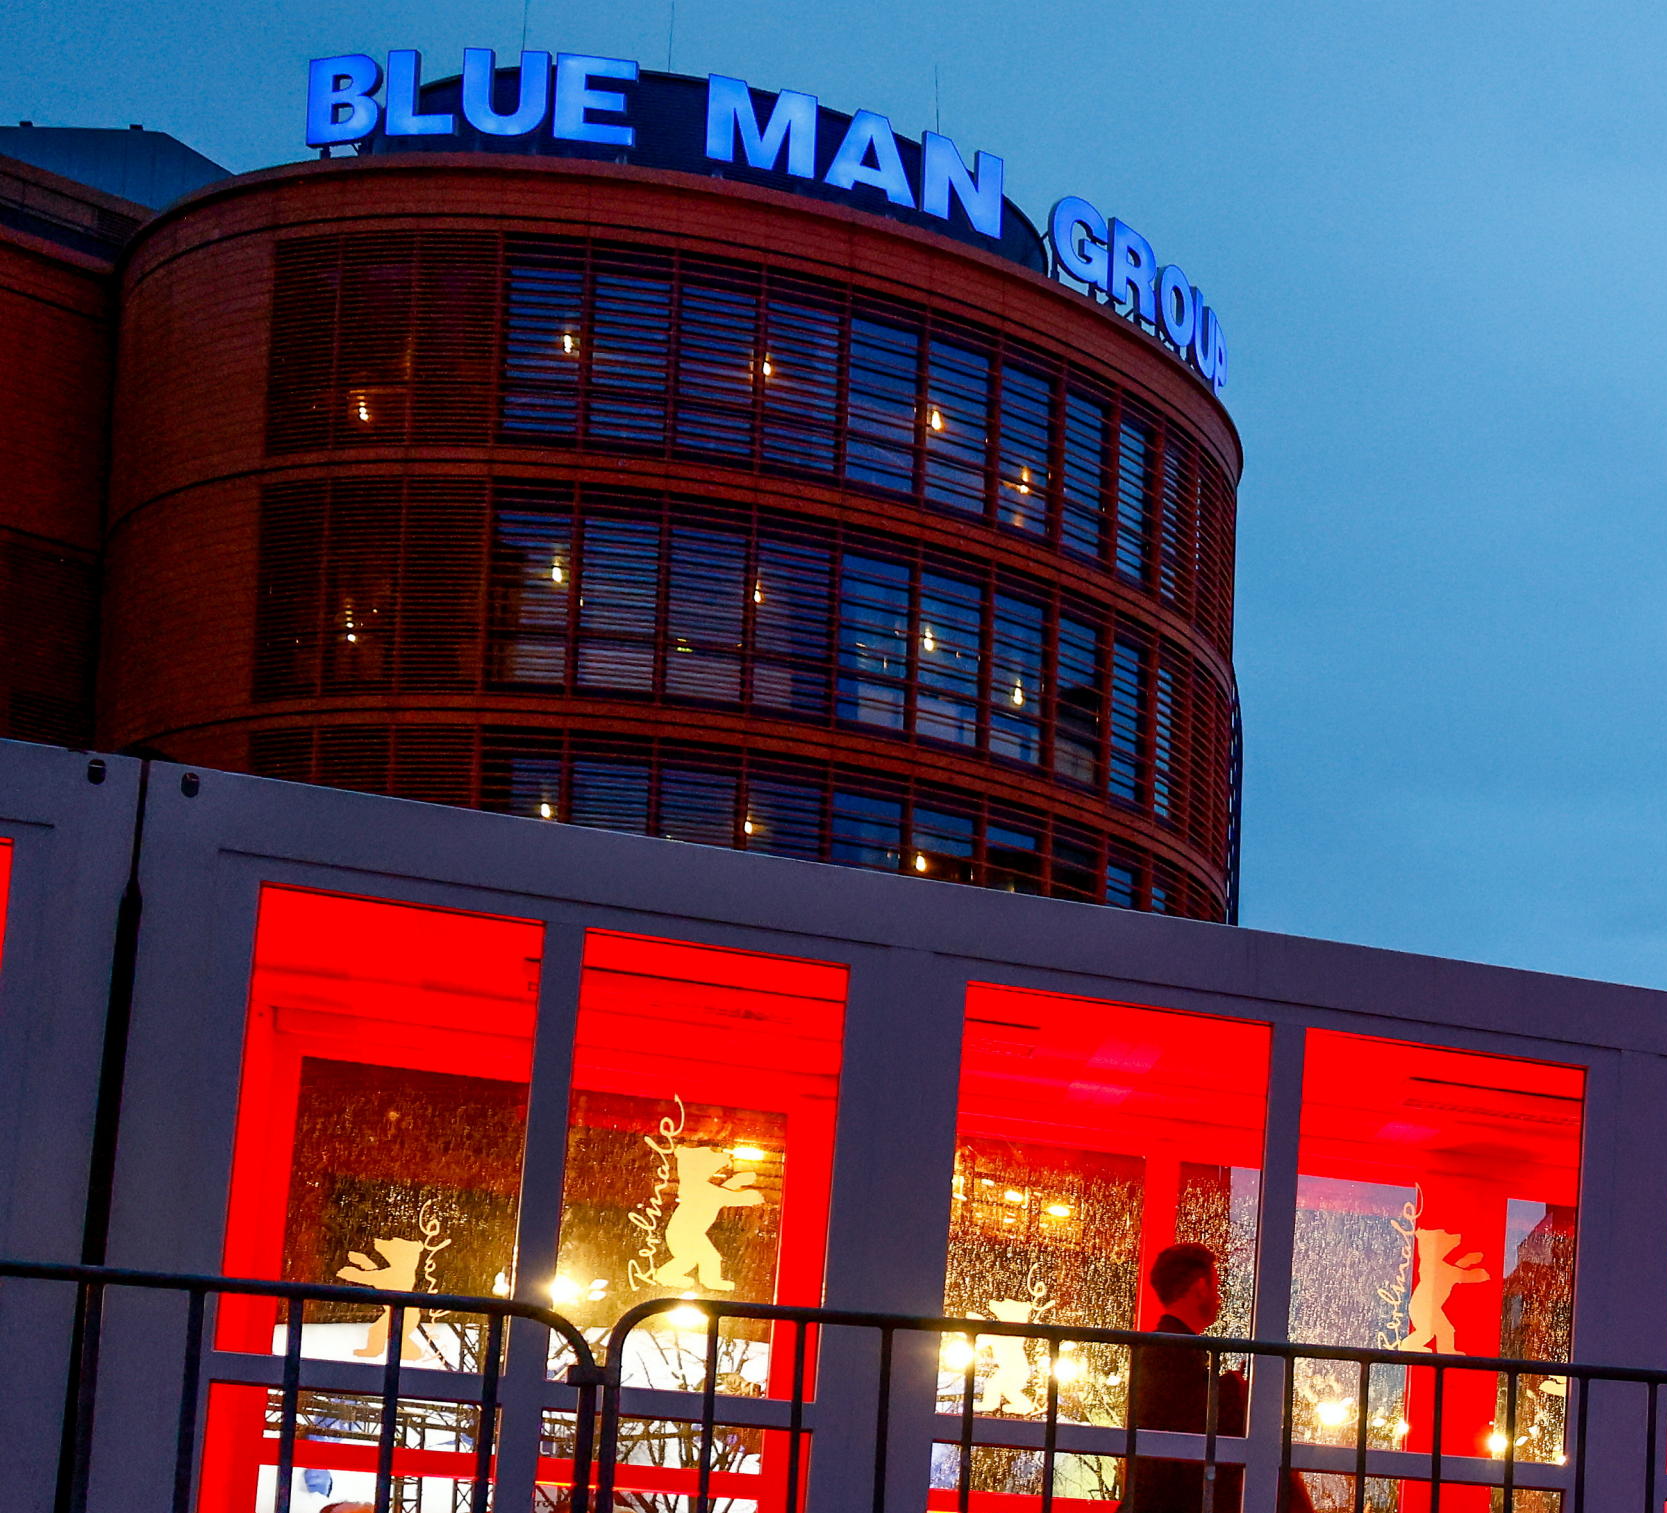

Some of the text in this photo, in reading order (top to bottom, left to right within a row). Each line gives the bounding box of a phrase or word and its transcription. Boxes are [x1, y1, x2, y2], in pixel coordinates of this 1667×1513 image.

[304, 48, 1229, 398] BLUE MAN GROUP
[628, 1093, 685, 1292] Berlinale
